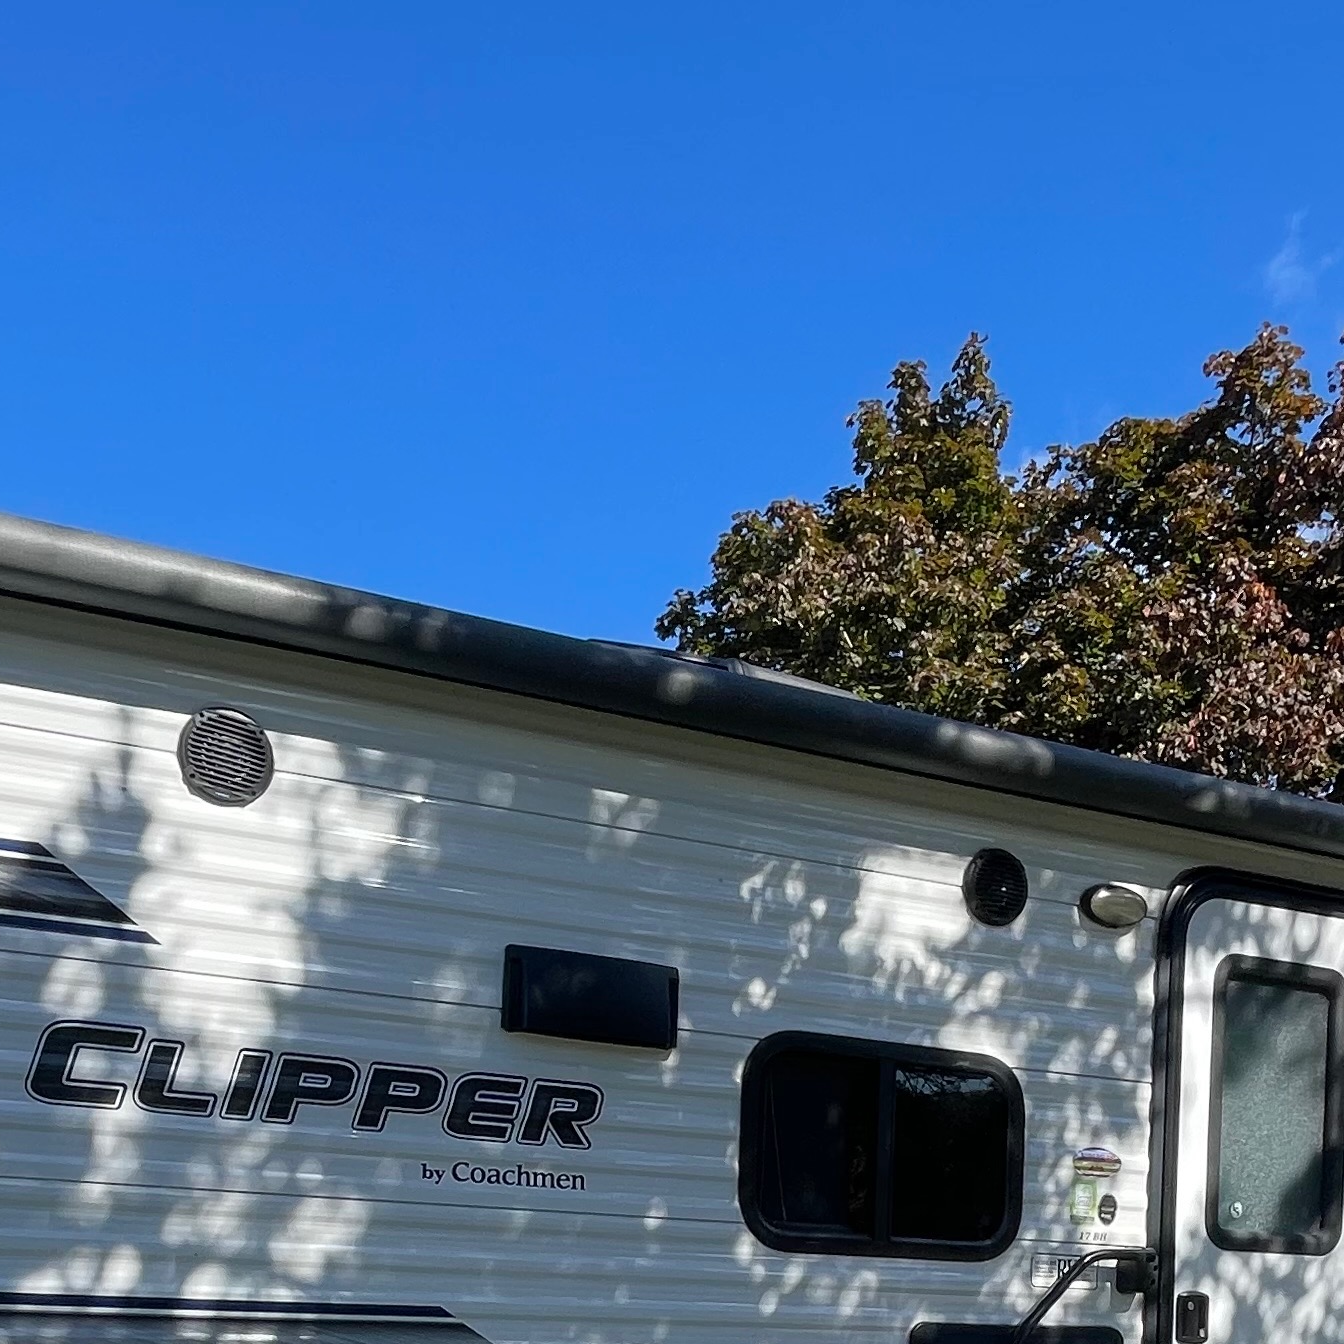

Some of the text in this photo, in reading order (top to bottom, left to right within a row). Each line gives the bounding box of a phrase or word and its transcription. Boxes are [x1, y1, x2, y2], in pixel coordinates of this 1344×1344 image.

[25, 1019, 604, 1150] CLIPPER
[421, 1162, 586, 1191] by Coachmen
[1079, 1231, 1091, 1240] 17
